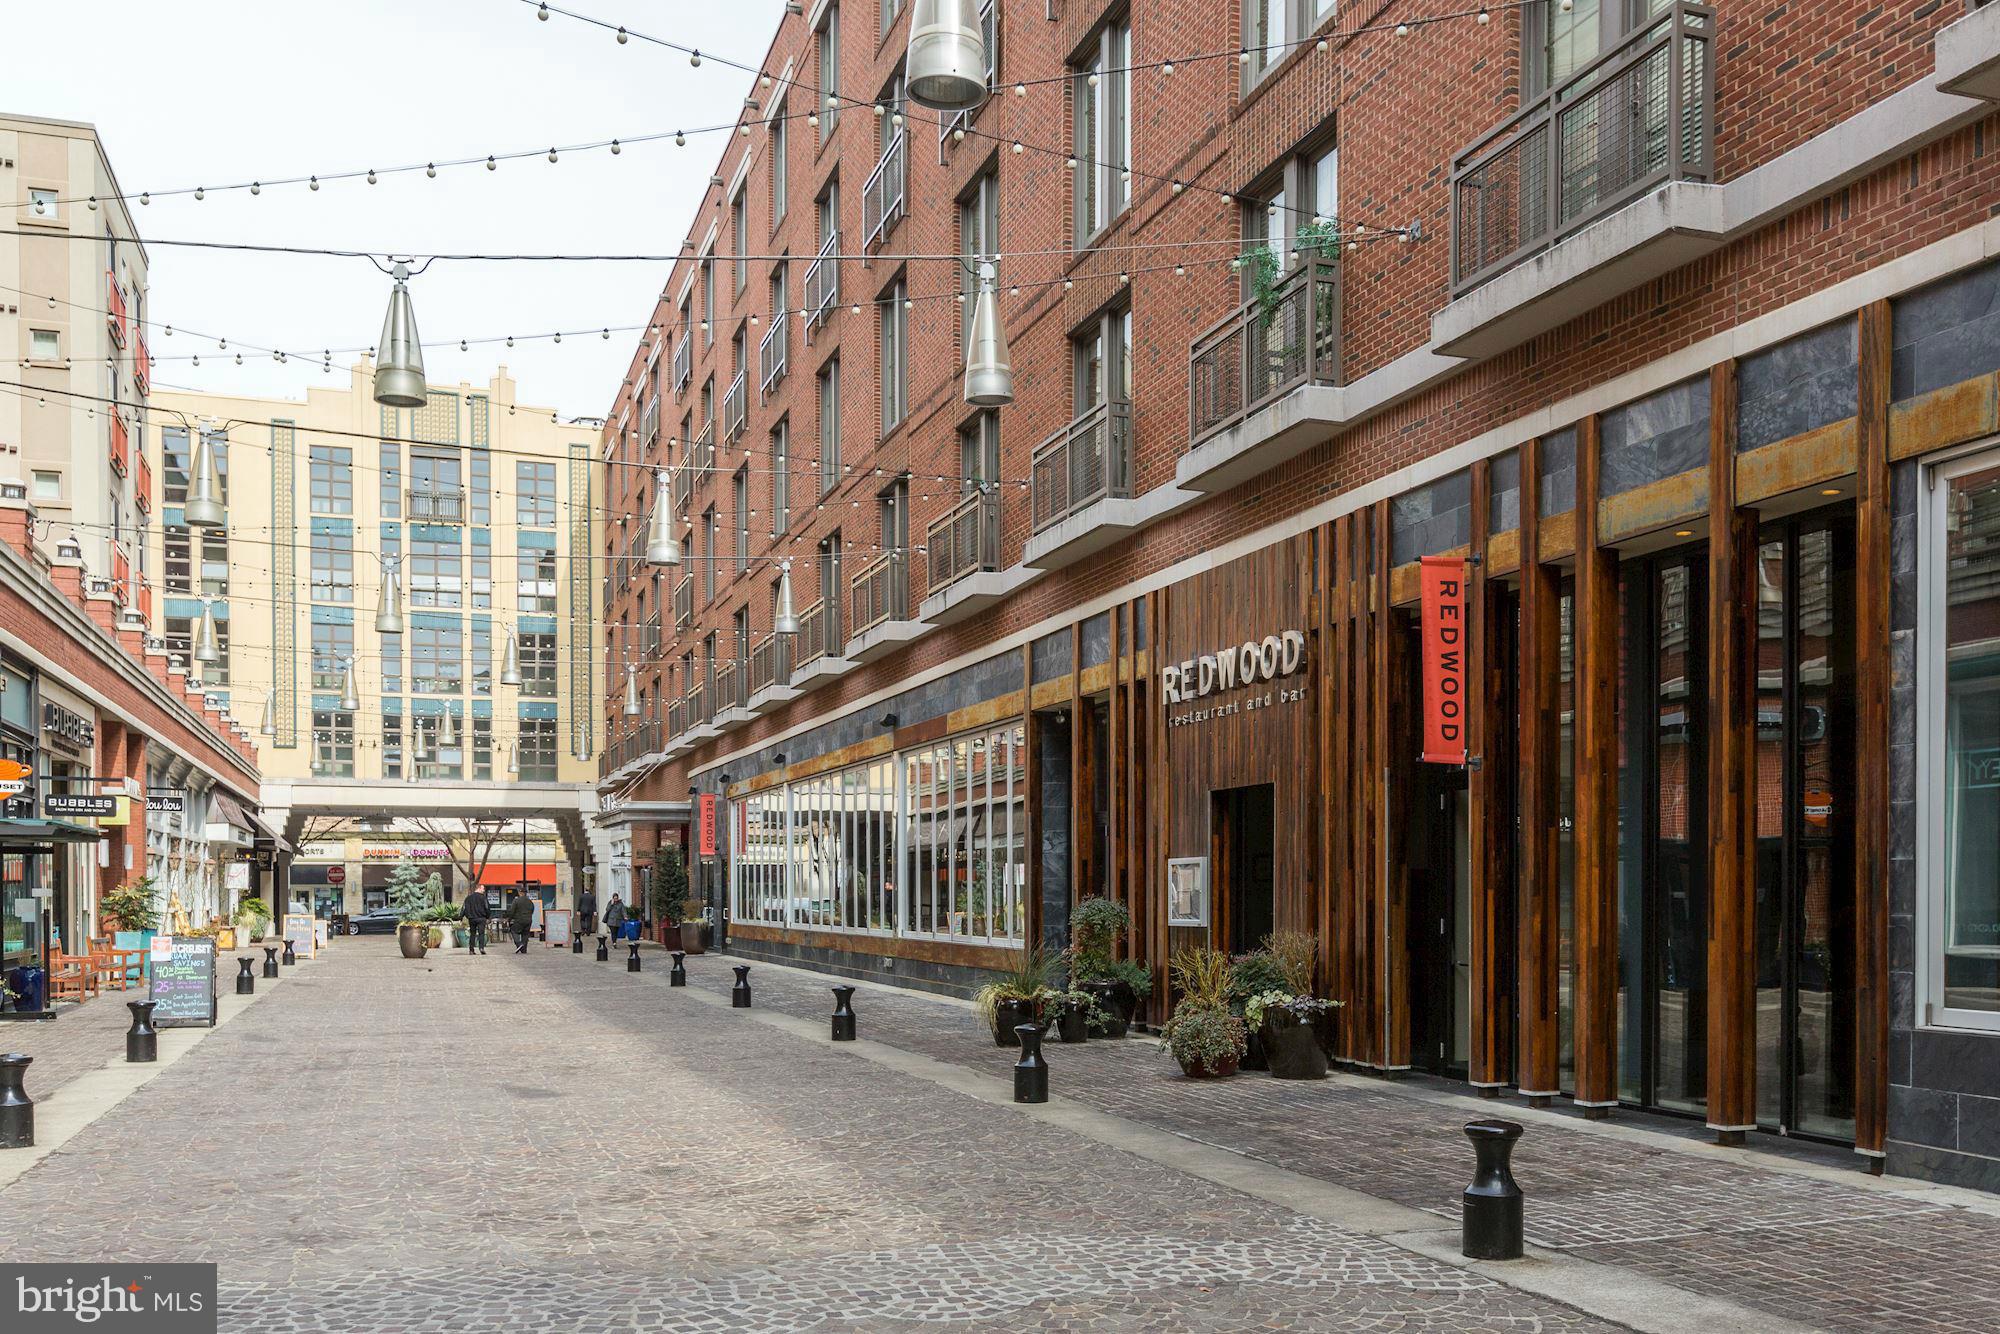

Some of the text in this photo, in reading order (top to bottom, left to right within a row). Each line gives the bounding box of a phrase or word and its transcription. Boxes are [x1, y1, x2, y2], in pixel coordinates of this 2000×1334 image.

[1162, 629, 1305, 706] REDWOOD
[1439, 580, 1459, 742] REDWOOD
[1168, 687, 1308, 729] restaurant and bar
[48, 797, 112, 808] BUBBLES
[705, 800, 714, 849] REDWOOD
[412, 848, 450, 856] DONUTS
[173, 959, 206, 967] SAVINGS
